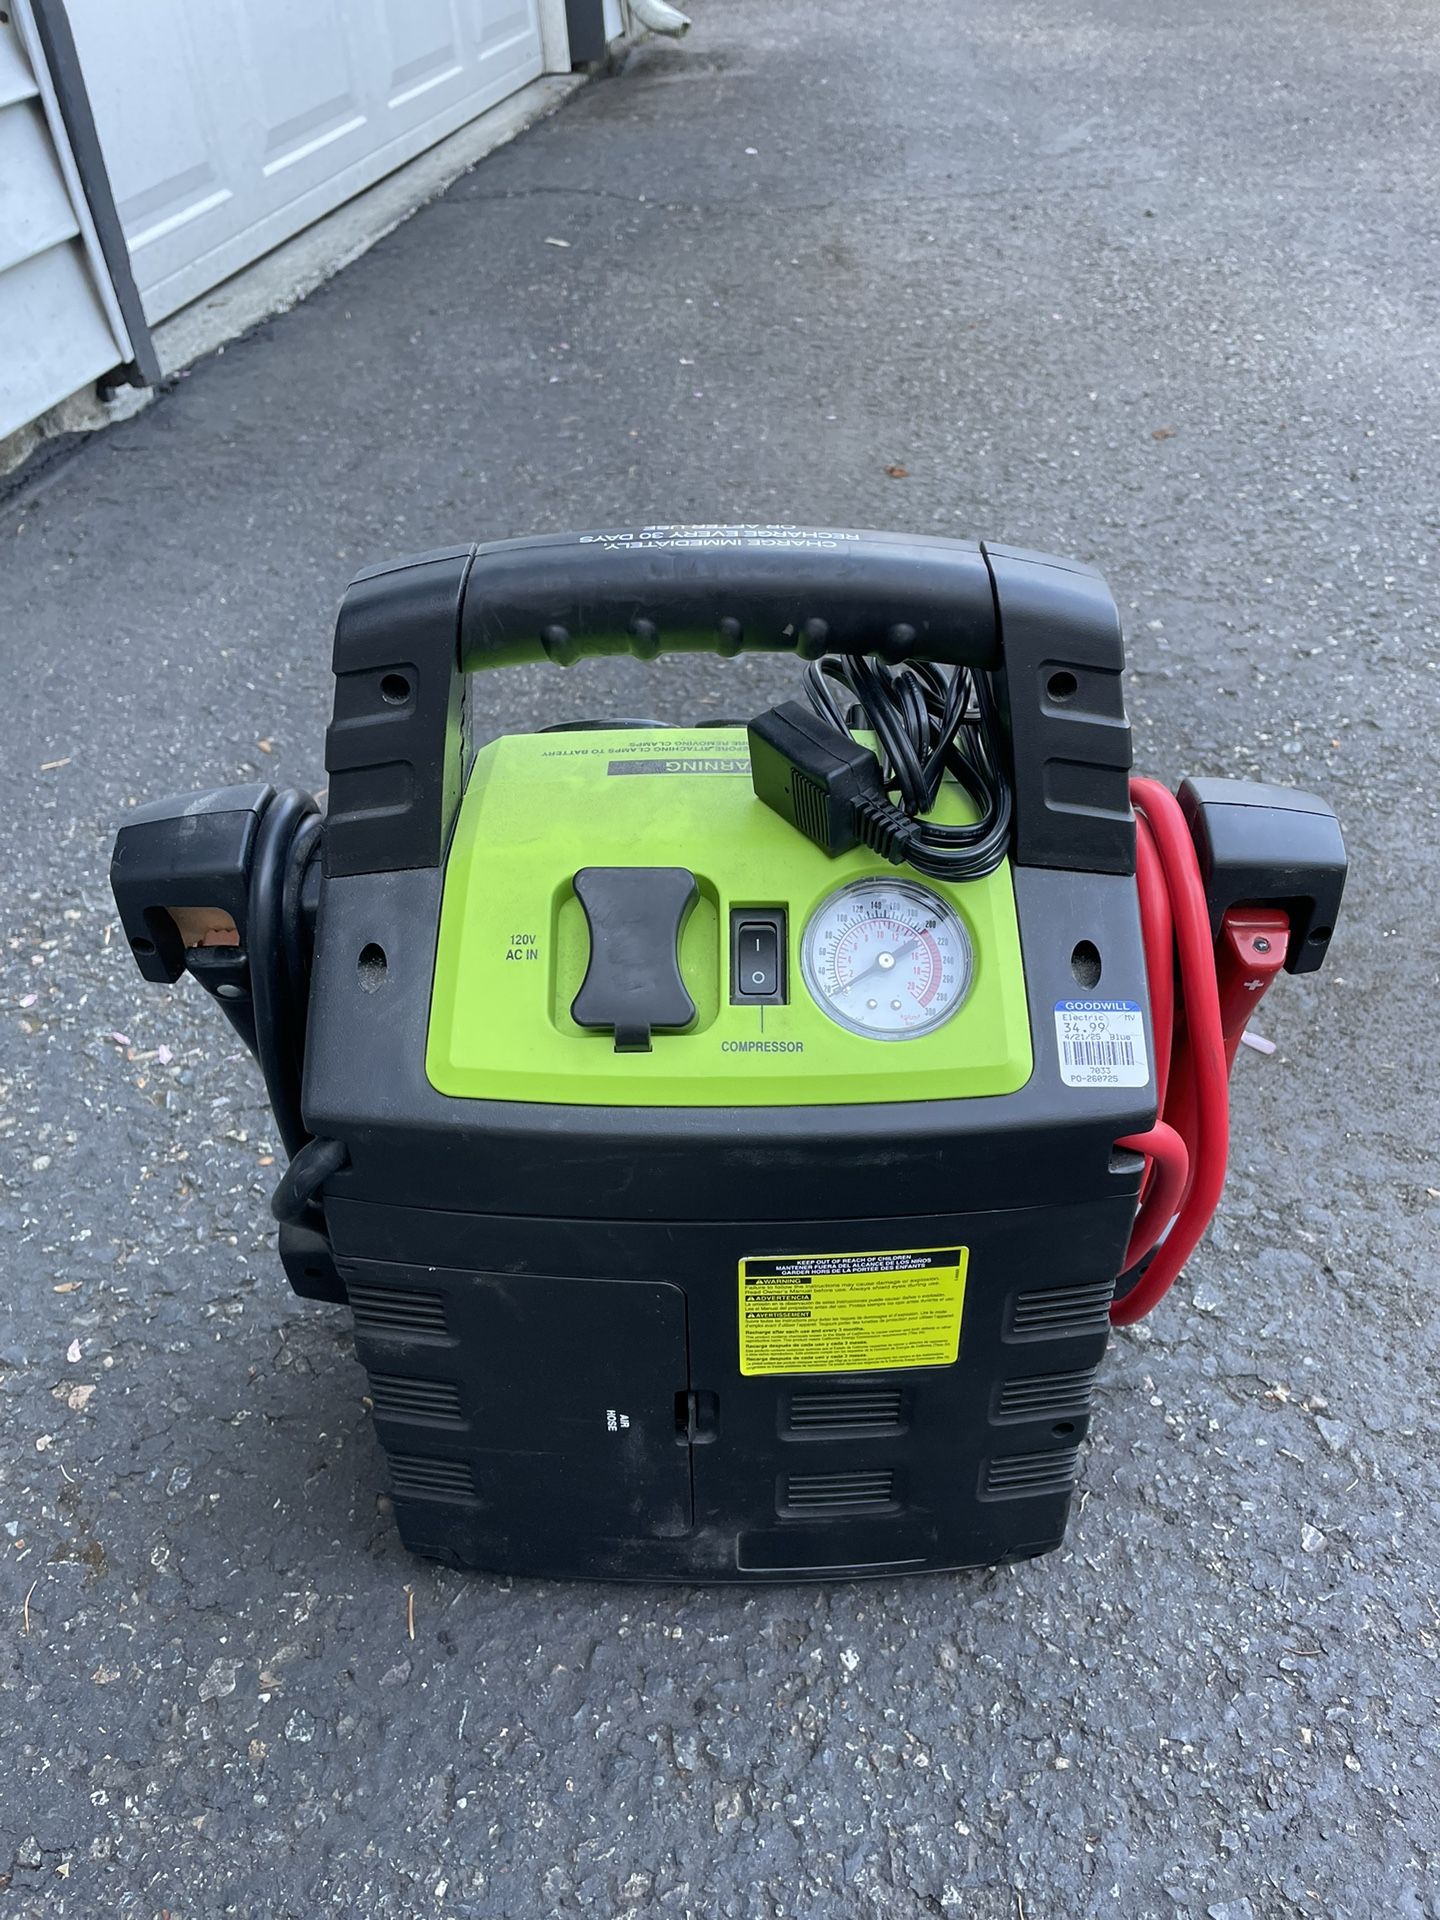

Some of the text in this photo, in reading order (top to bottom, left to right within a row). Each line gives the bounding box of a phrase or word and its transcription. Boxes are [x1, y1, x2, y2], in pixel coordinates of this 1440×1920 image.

[580, 533, 633, 543] DAYS
[744, 530, 860, 540] RECHARGE
[747, 539, 837, 548] CHARGE
[666, 761, 748, 771] ARNING
[511, 934, 536, 945] 120V
[938, 938, 948, 946] 220
[506, 949, 538, 960] AC IN
[943, 956, 954, 965] 240
[1066, 1002, 1130, 1010] GOODWILL
[1064, 1023, 1105, 1032] 34.99
[722, 1041, 804, 1052] COMPRESSOR
[606, 1409, 618, 1432] HOSE
[620, 1414, 630, 1428] AIR
